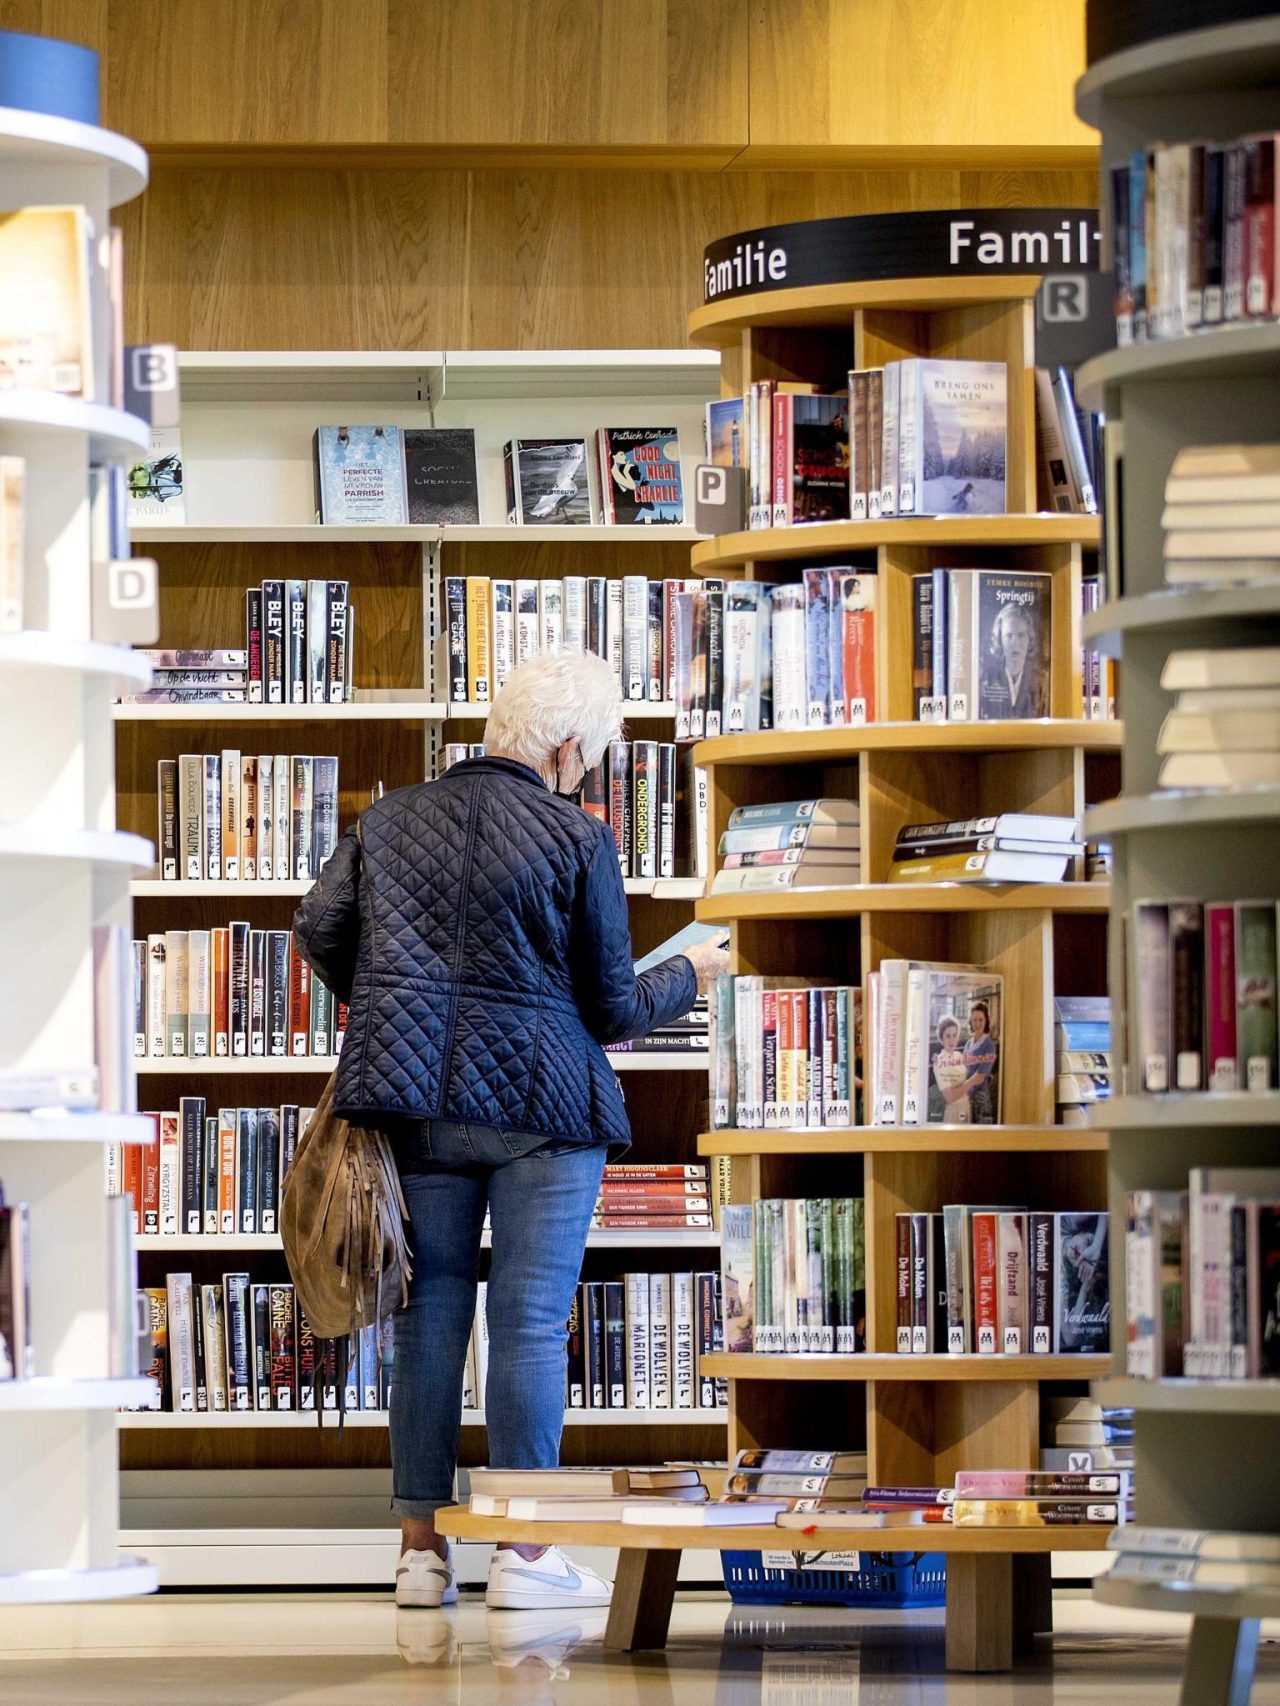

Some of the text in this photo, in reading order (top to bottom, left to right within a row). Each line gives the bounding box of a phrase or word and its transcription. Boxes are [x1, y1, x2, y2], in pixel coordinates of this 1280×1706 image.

[949, 221, 1103, 265] Famil
[704, 242, 787, 299] Familie
[1051, 283, 1082, 314] R
[140, 354, 168, 383] B
[934, 380, 969, 390] BRENG
[612, 430, 675, 440] Patrick Conrad
[633, 446, 661, 463] GOOD
[634, 485, 679, 503] CHARLIE
[702, 472, 721, 499] P
[118, 571, 146, 600] D
[569, 582, 578, 617] CARLSSON
[627, 582, 635, 617] CARLSSON
[996, 590, 1035, 606] Springtij
[268, 601, 281, 637] BLEY
[293, 602, 304, 639] BLEY
[331, 602, 345, 638] BLEY
[476, 586, 485, 661] HET MEISJE MET ALLE
[920, 584, 932, 634] Nora Roberts
[451, 622, 459, 655] GAME
[710, 607, 721, 658] Levensecht
[250, 630, 260, 681] DE ANDEREN
[168, 671, 219, 684] Op de vlucht
[168, 690, 221, 703] Onvindbaar
[613, 779, 623, 792] DE
[637, 779, 647, 854] ONDERGRONDS
[275, 940, 284, 963] PATRICIA
[197, 955, 207, 1012] Witte chrysant
[275, 964, 284, 988] BRIGGS
[253, 978, 264, 1018] DE IJSVOGEL
[317, 989, 326, 1032] verwisselin
[339, 1013, 348, 1024] DE
[890, 1013, 899, 1056] De vrouw
[764, 1035, 775, 1074] Vergeten
[780, 1052, 789, 1072] Liefde
[780, 1073, 787, 1081] op
[780, 1082, 789, 1091] de
[187, 1155, 193, 1164] OP
[223, 1135, 234, 1176] OOG IN OOG
[145, 1165, 158, 1203] Zinneling
[726, 1223, 752, 1239] WILL
[899, 1257, 909, 1297] De Molen
[915, 1257, 925, 1298] De Molen
[1006, 1252, 1018, 1296] Drijfzand
[1036, 1223, 1048, 1322] Verdwaald José Vriens
[159, 1298, 167, 1328] RACHEL
[272, 1290, 285, 1328] CAINE
[284, 1292, 292, 1325] RACHEL
[1064, 1302, 1110, 1323] Verdwaald
[614, 1336, 620, 1345] DE
[654, 1325, 667, 1338] DE
[678, 1324, 691, 1337] DE
[634, 1325, 646, 1385] MARIONET
[654, 1341, 667, 1386] WOLVEN
[678, 1341, 691, 1386] WOLVEN
[272, 1355, 284, 1396] FALLS
